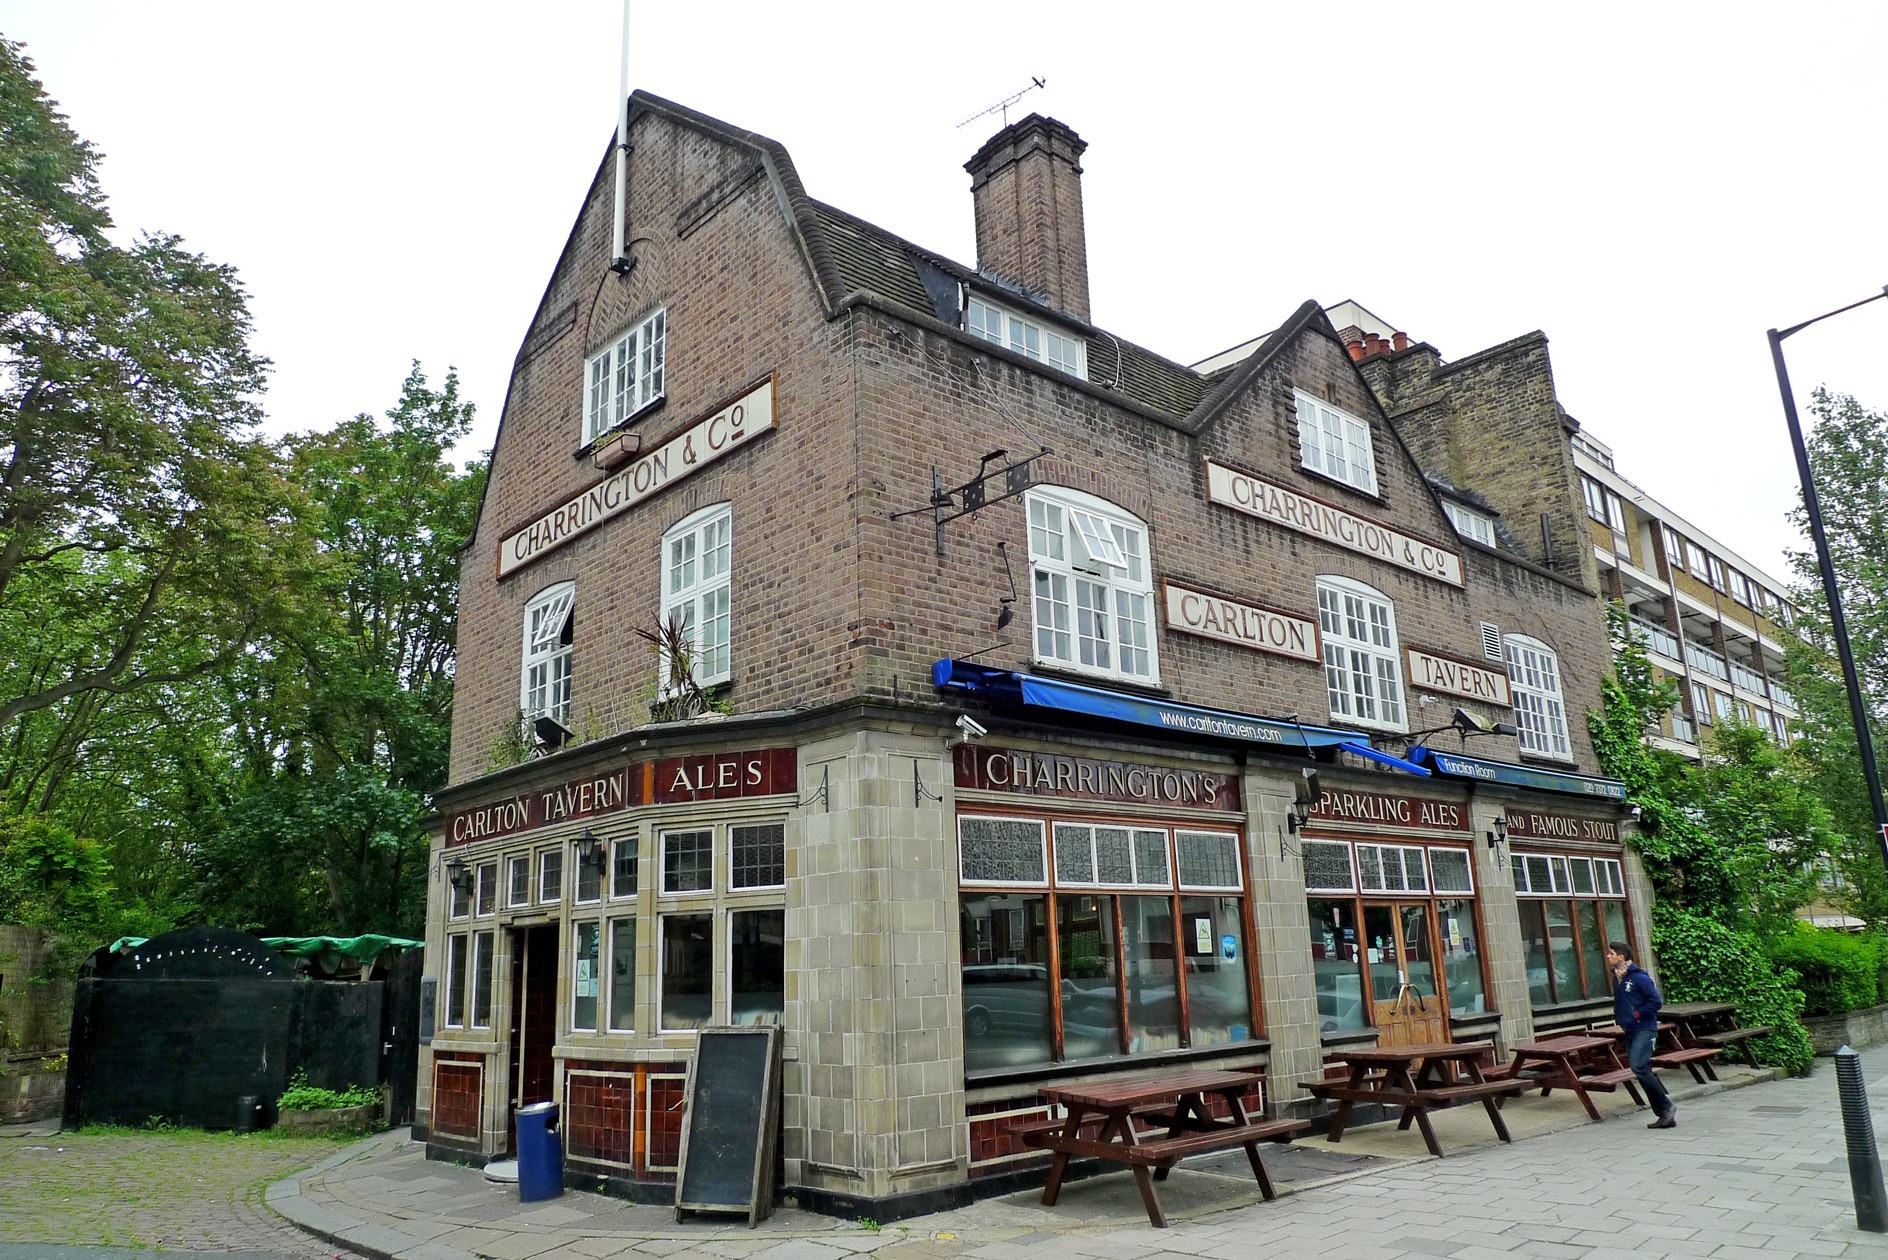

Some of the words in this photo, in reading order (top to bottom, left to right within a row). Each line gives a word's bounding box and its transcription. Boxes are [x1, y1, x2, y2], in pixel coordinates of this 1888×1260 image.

[514, 448, 669, 561] CHARRINGTON
[682, 435, 696, 465] &
[1231, 475, 1394, 558] CHARRINGTON
[1403, 540, 1415, 566] &
[1181, 594, 1305, 652] CARLTON
[1420, 656, 1497, 699] TAVERN
[1159, 711, 1283, 741] www.carltontavern.com
[670, 760, 763, 793] ALES
[986, 753, 1217, 804] CHARRINGTON'S
[1443, 758, 1475, 776] Function
[1475, 764, 1496, 779] Room
[453, 799, 530, 842] CARLTON
[542, 773, 624, 822] TAVERN
[1420, 802, 1459, 827] ALES
[1507, 814, 1525, 830] AND
[1531, 814, 1578, 837] FAMOUS
[1582, 820, 1616, 841] STOUT
